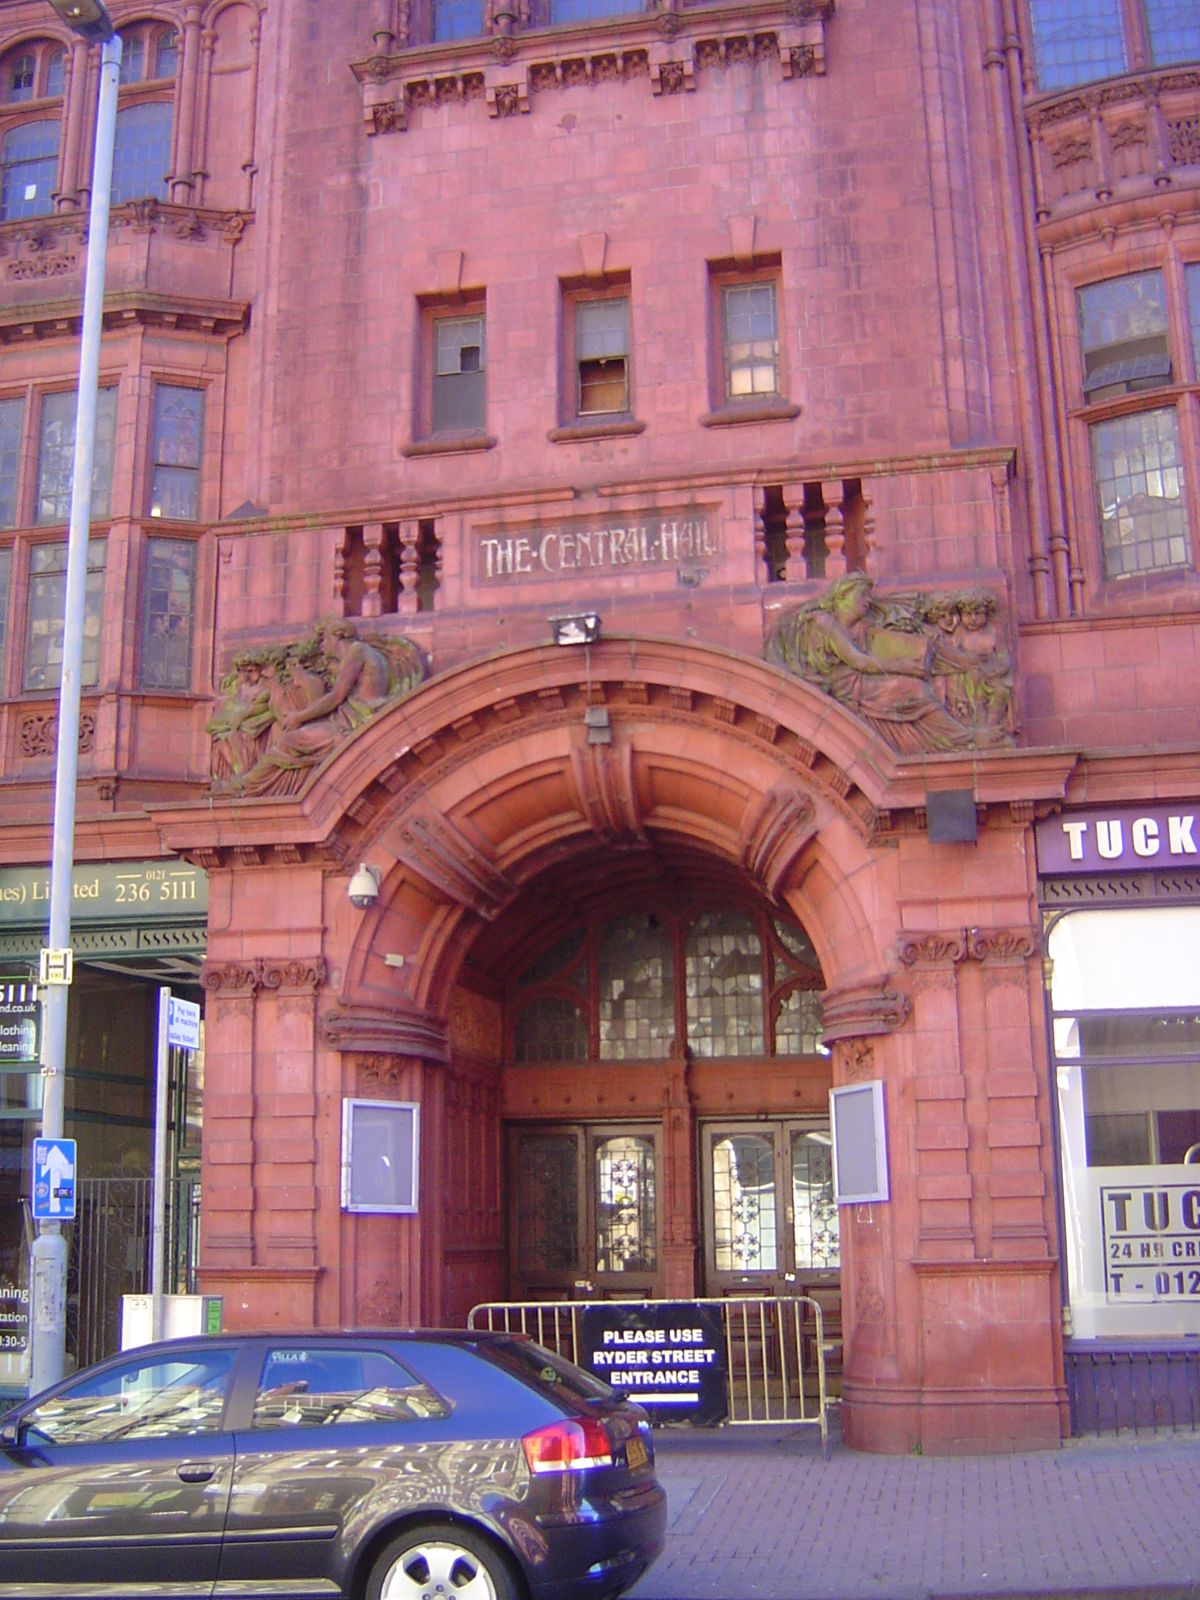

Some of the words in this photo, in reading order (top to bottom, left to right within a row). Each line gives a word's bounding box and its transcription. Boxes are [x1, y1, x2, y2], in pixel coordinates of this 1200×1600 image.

[480, 538, 532, 578] THE
[540, 527, 657, 573] CENTRAL
[661, 521, 717, 560] HALL
[1062, 816, 1198, 860] TUCK
[145, 870, 166, 880] 0121
[32, 879, 99, 901] Lited
[115, 882, 151, 902] 236
[159, 880, 197, 900] 5111
[1110, 1243, 1132, 1259] 24
[1140, 1242, 1164, 1258] HR
[1172, 1240, 1200, 1257] CR
[1110, 1273, 1124, 1296] T
[1155, 1270, 1200, 1296] 012
[603, 1330, 665, 1344] PLEASE
[669, 1328, 704, 1343] USE
[593, 1351, 650, 1365] RYDER
[651, 1349, 715, 1364] STREET
[610, 1371, 700, 1385] ENTRANCE
